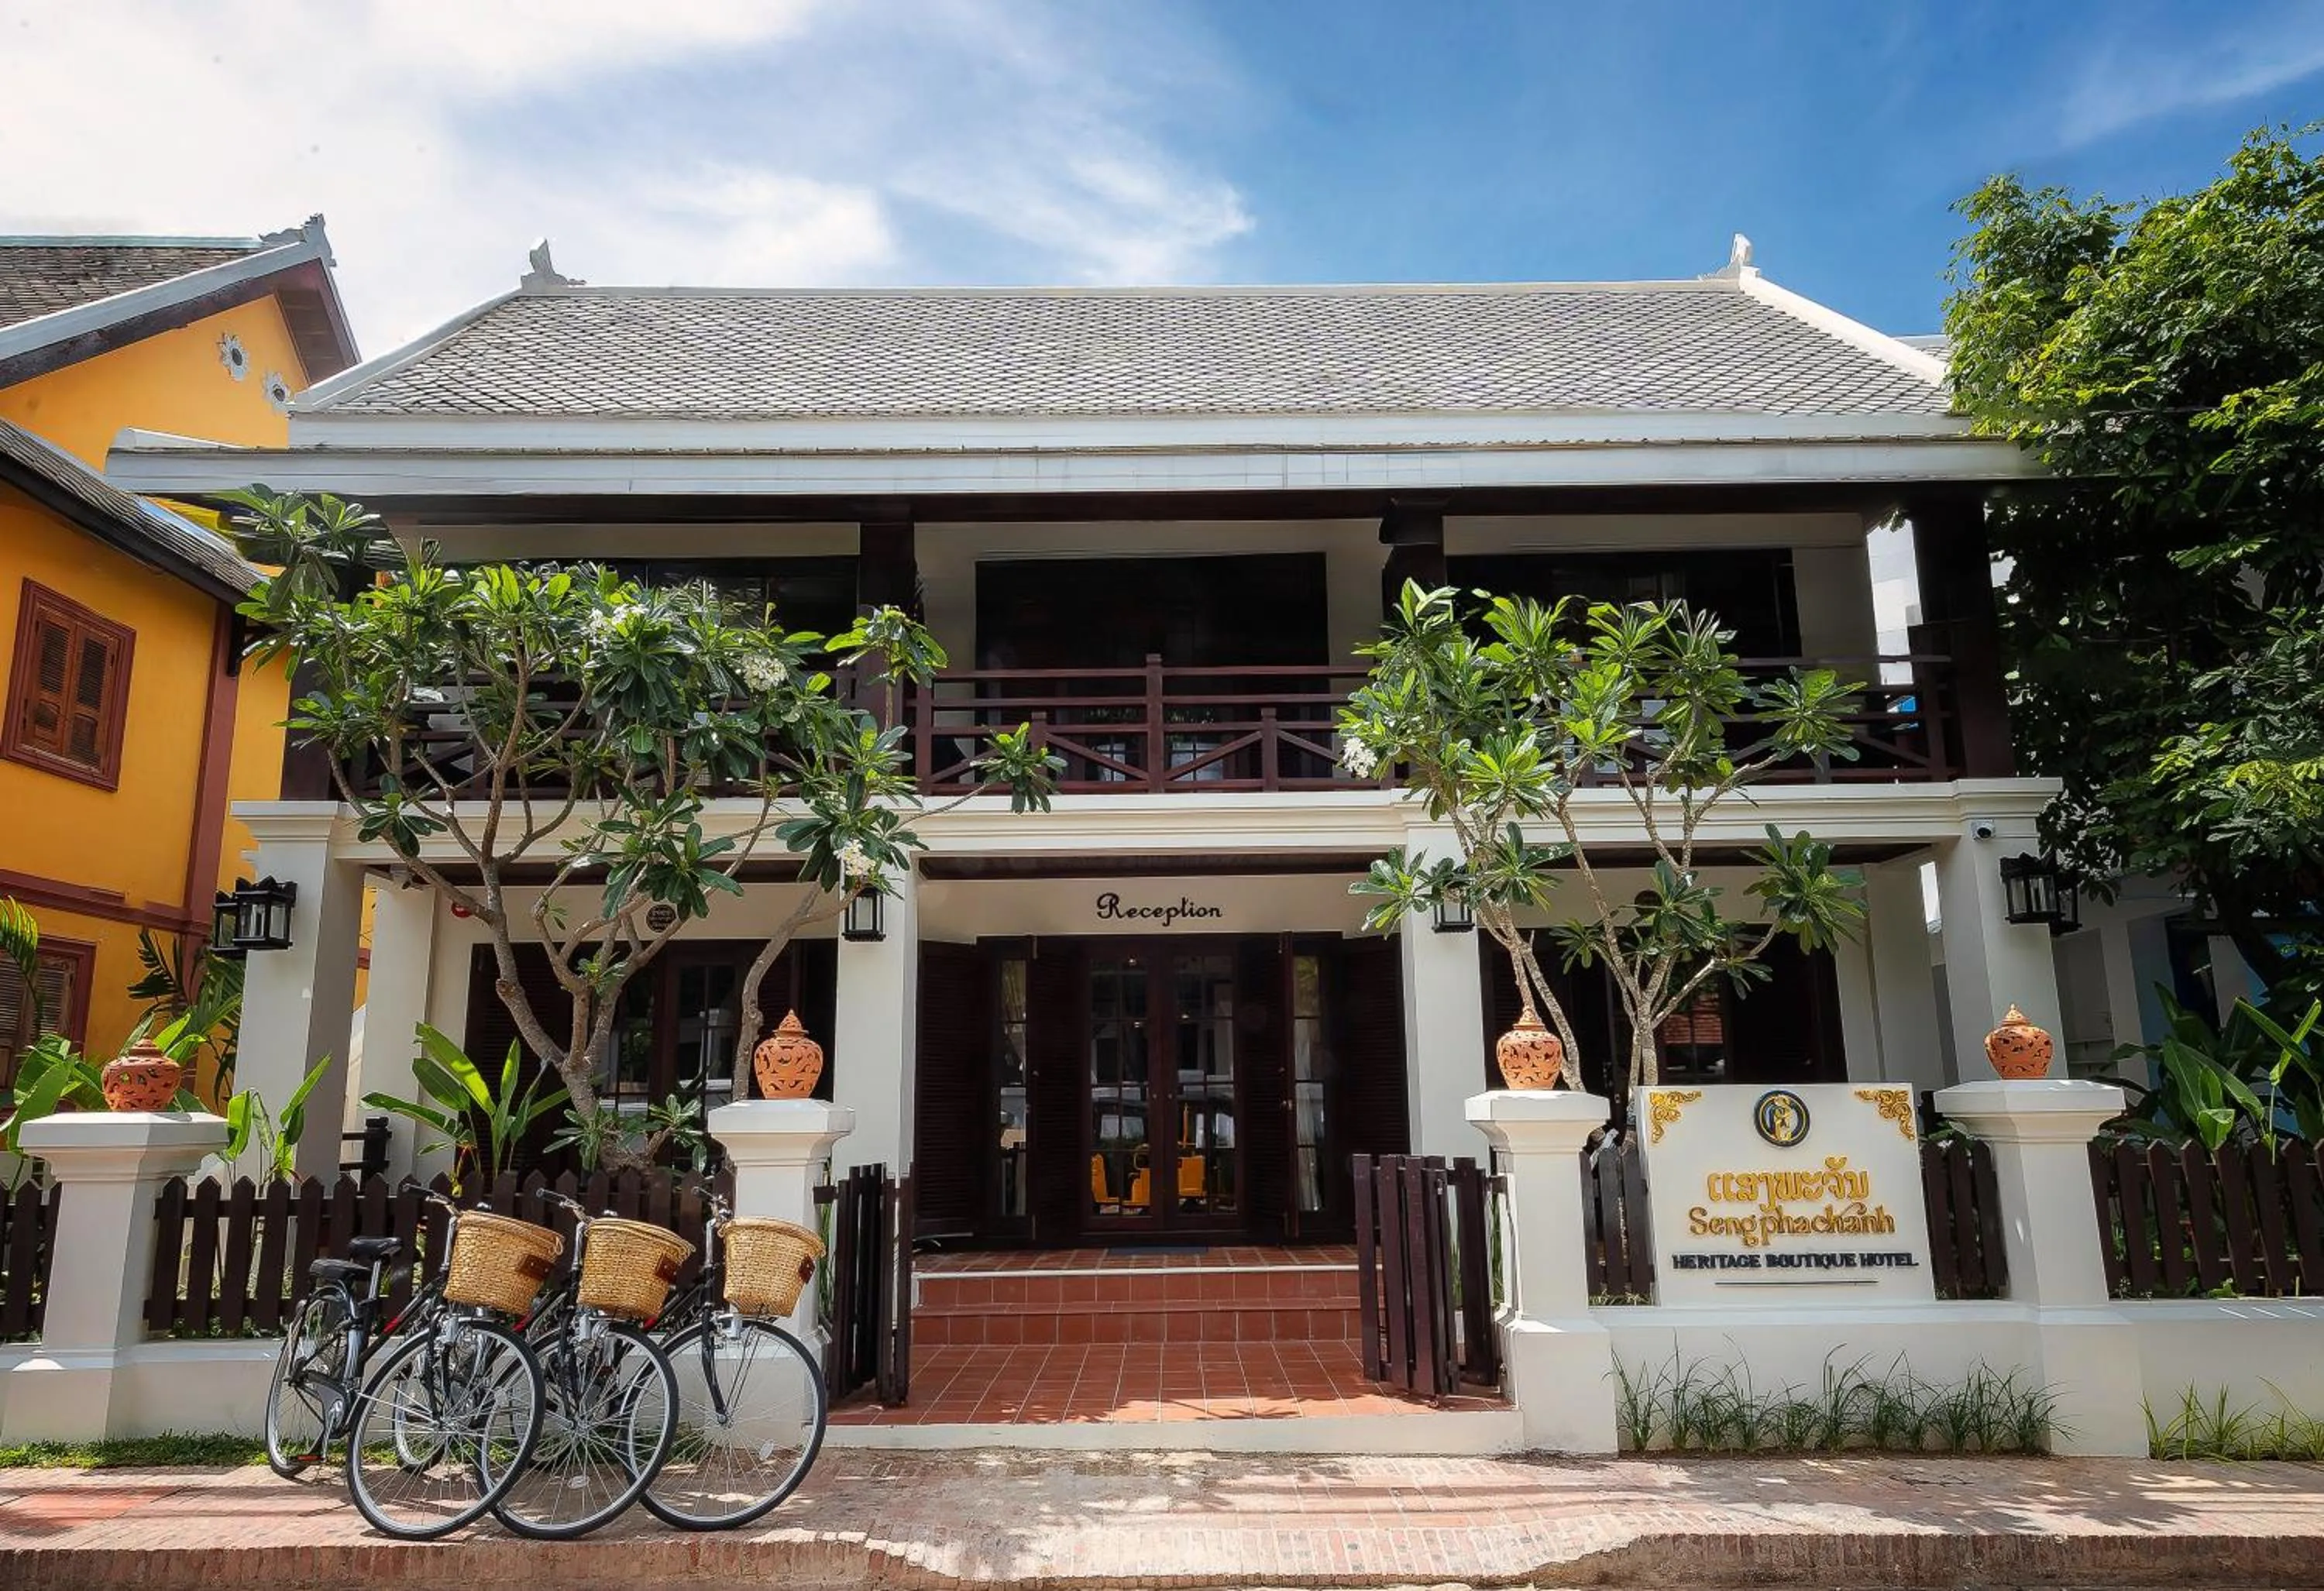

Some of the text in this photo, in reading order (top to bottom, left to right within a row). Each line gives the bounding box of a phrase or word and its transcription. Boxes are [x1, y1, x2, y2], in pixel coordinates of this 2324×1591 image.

[1096, 892, 1222, 927] Reception
[1672, 1252, 1920, 1270] HERITAGE BOUTIQUE HOTEL
